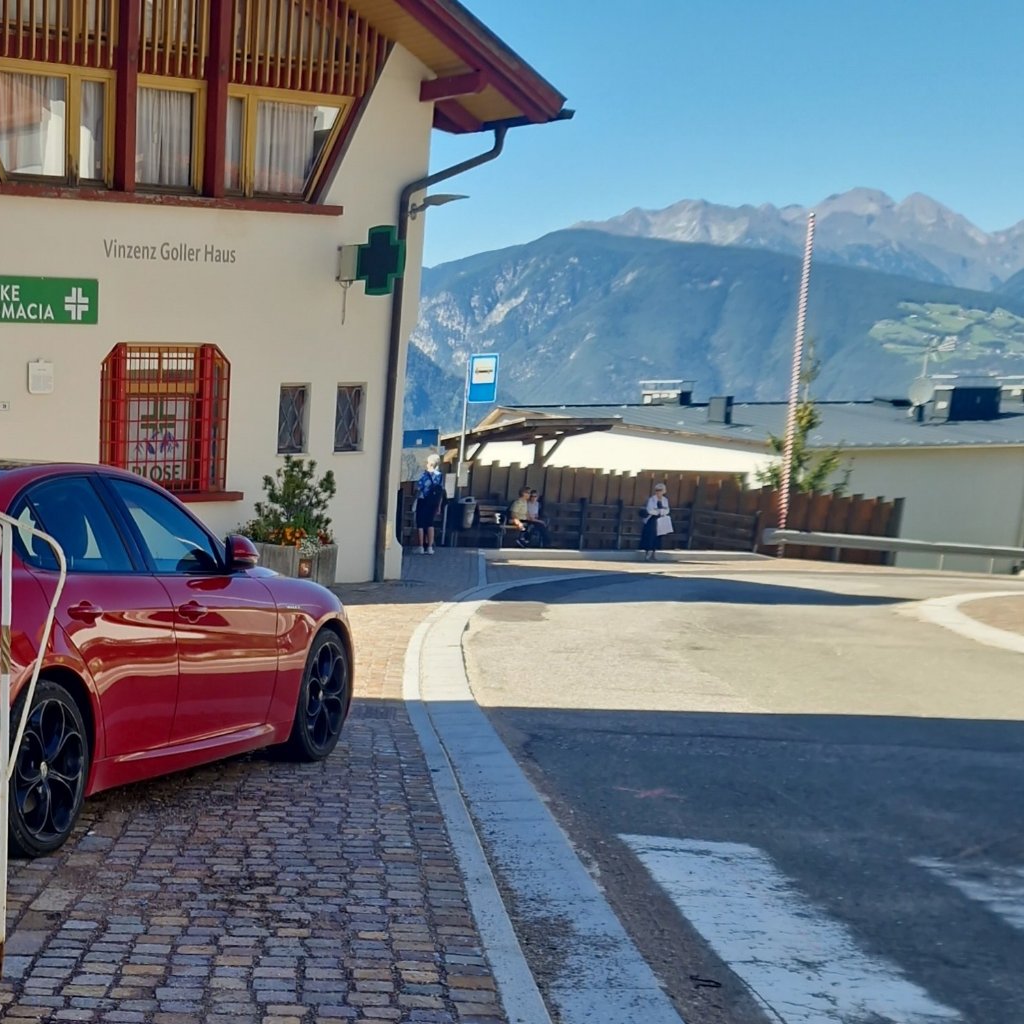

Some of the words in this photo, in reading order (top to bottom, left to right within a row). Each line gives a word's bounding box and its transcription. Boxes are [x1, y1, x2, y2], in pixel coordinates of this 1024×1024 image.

[103, 238, 157, 260] Vinzenz
[160, 242, 201, 262] Goller
[204, 244, 236, 263] Haus
